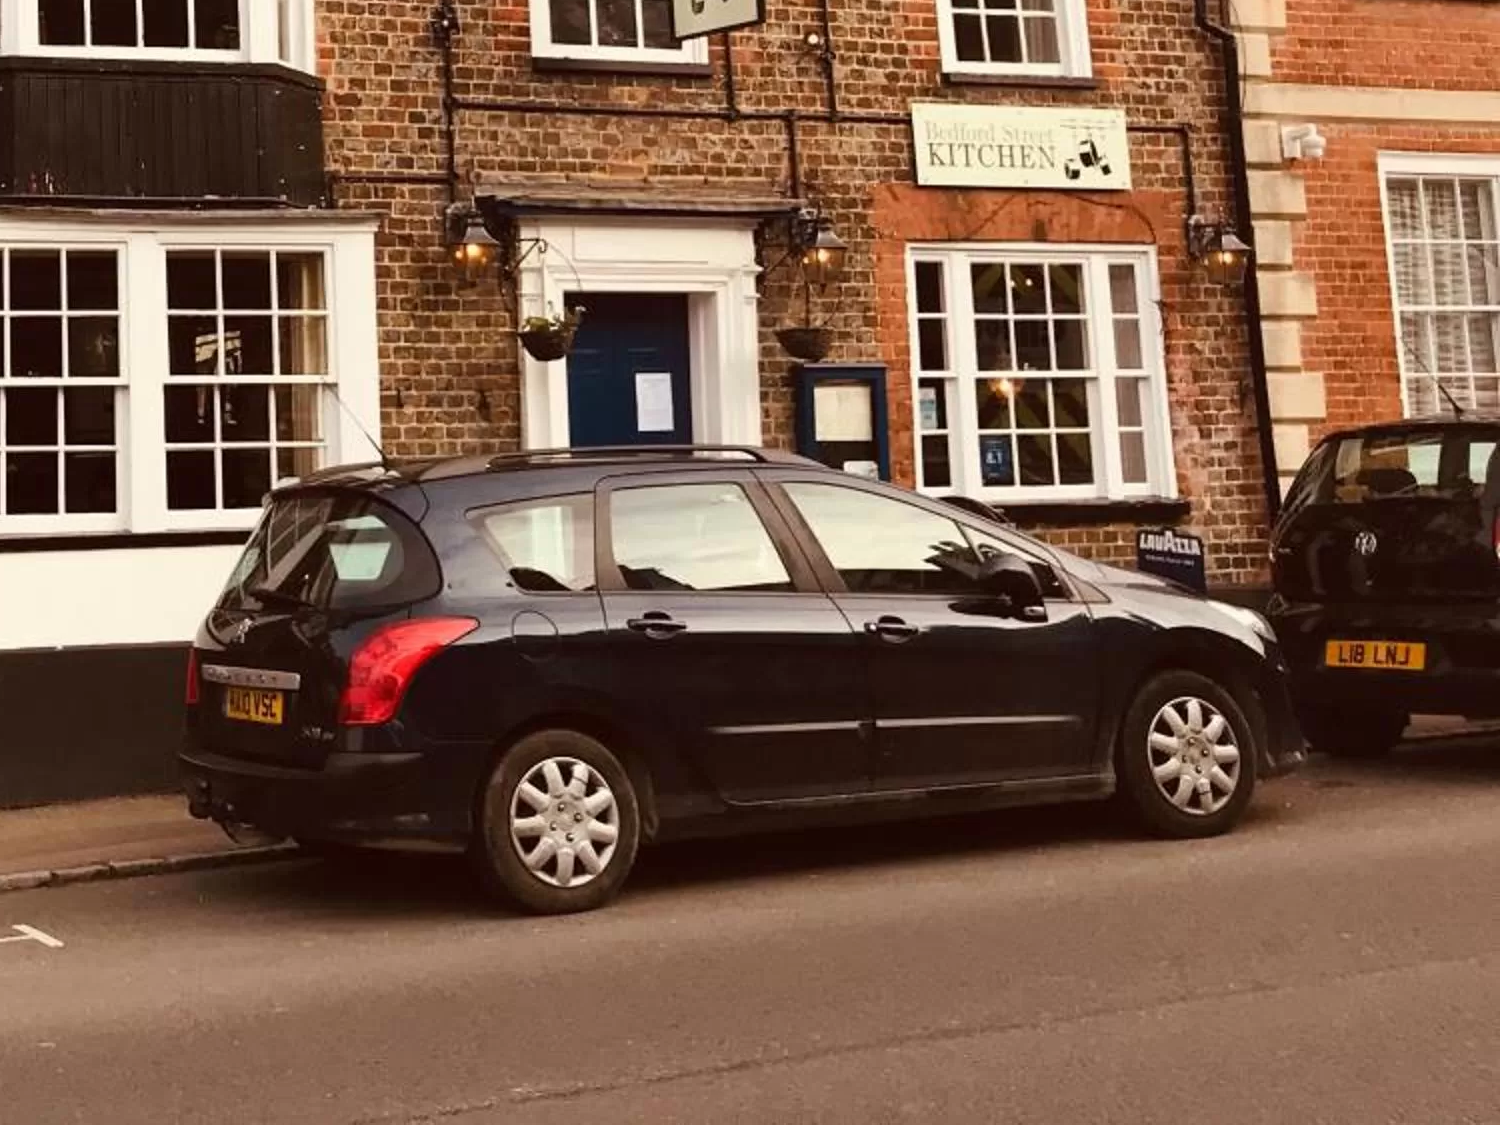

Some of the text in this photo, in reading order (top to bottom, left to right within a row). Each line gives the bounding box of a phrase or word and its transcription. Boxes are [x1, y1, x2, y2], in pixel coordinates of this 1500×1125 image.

[924, 120, 995, 142] Bedford
[926, 142, 1056, 169] KITCHEN
[1140, 530, 1201, 555] LAVAZZA
[1337, 643, 1411, 665] L18 LNJ
[253, 691, 277, 717] VSC
